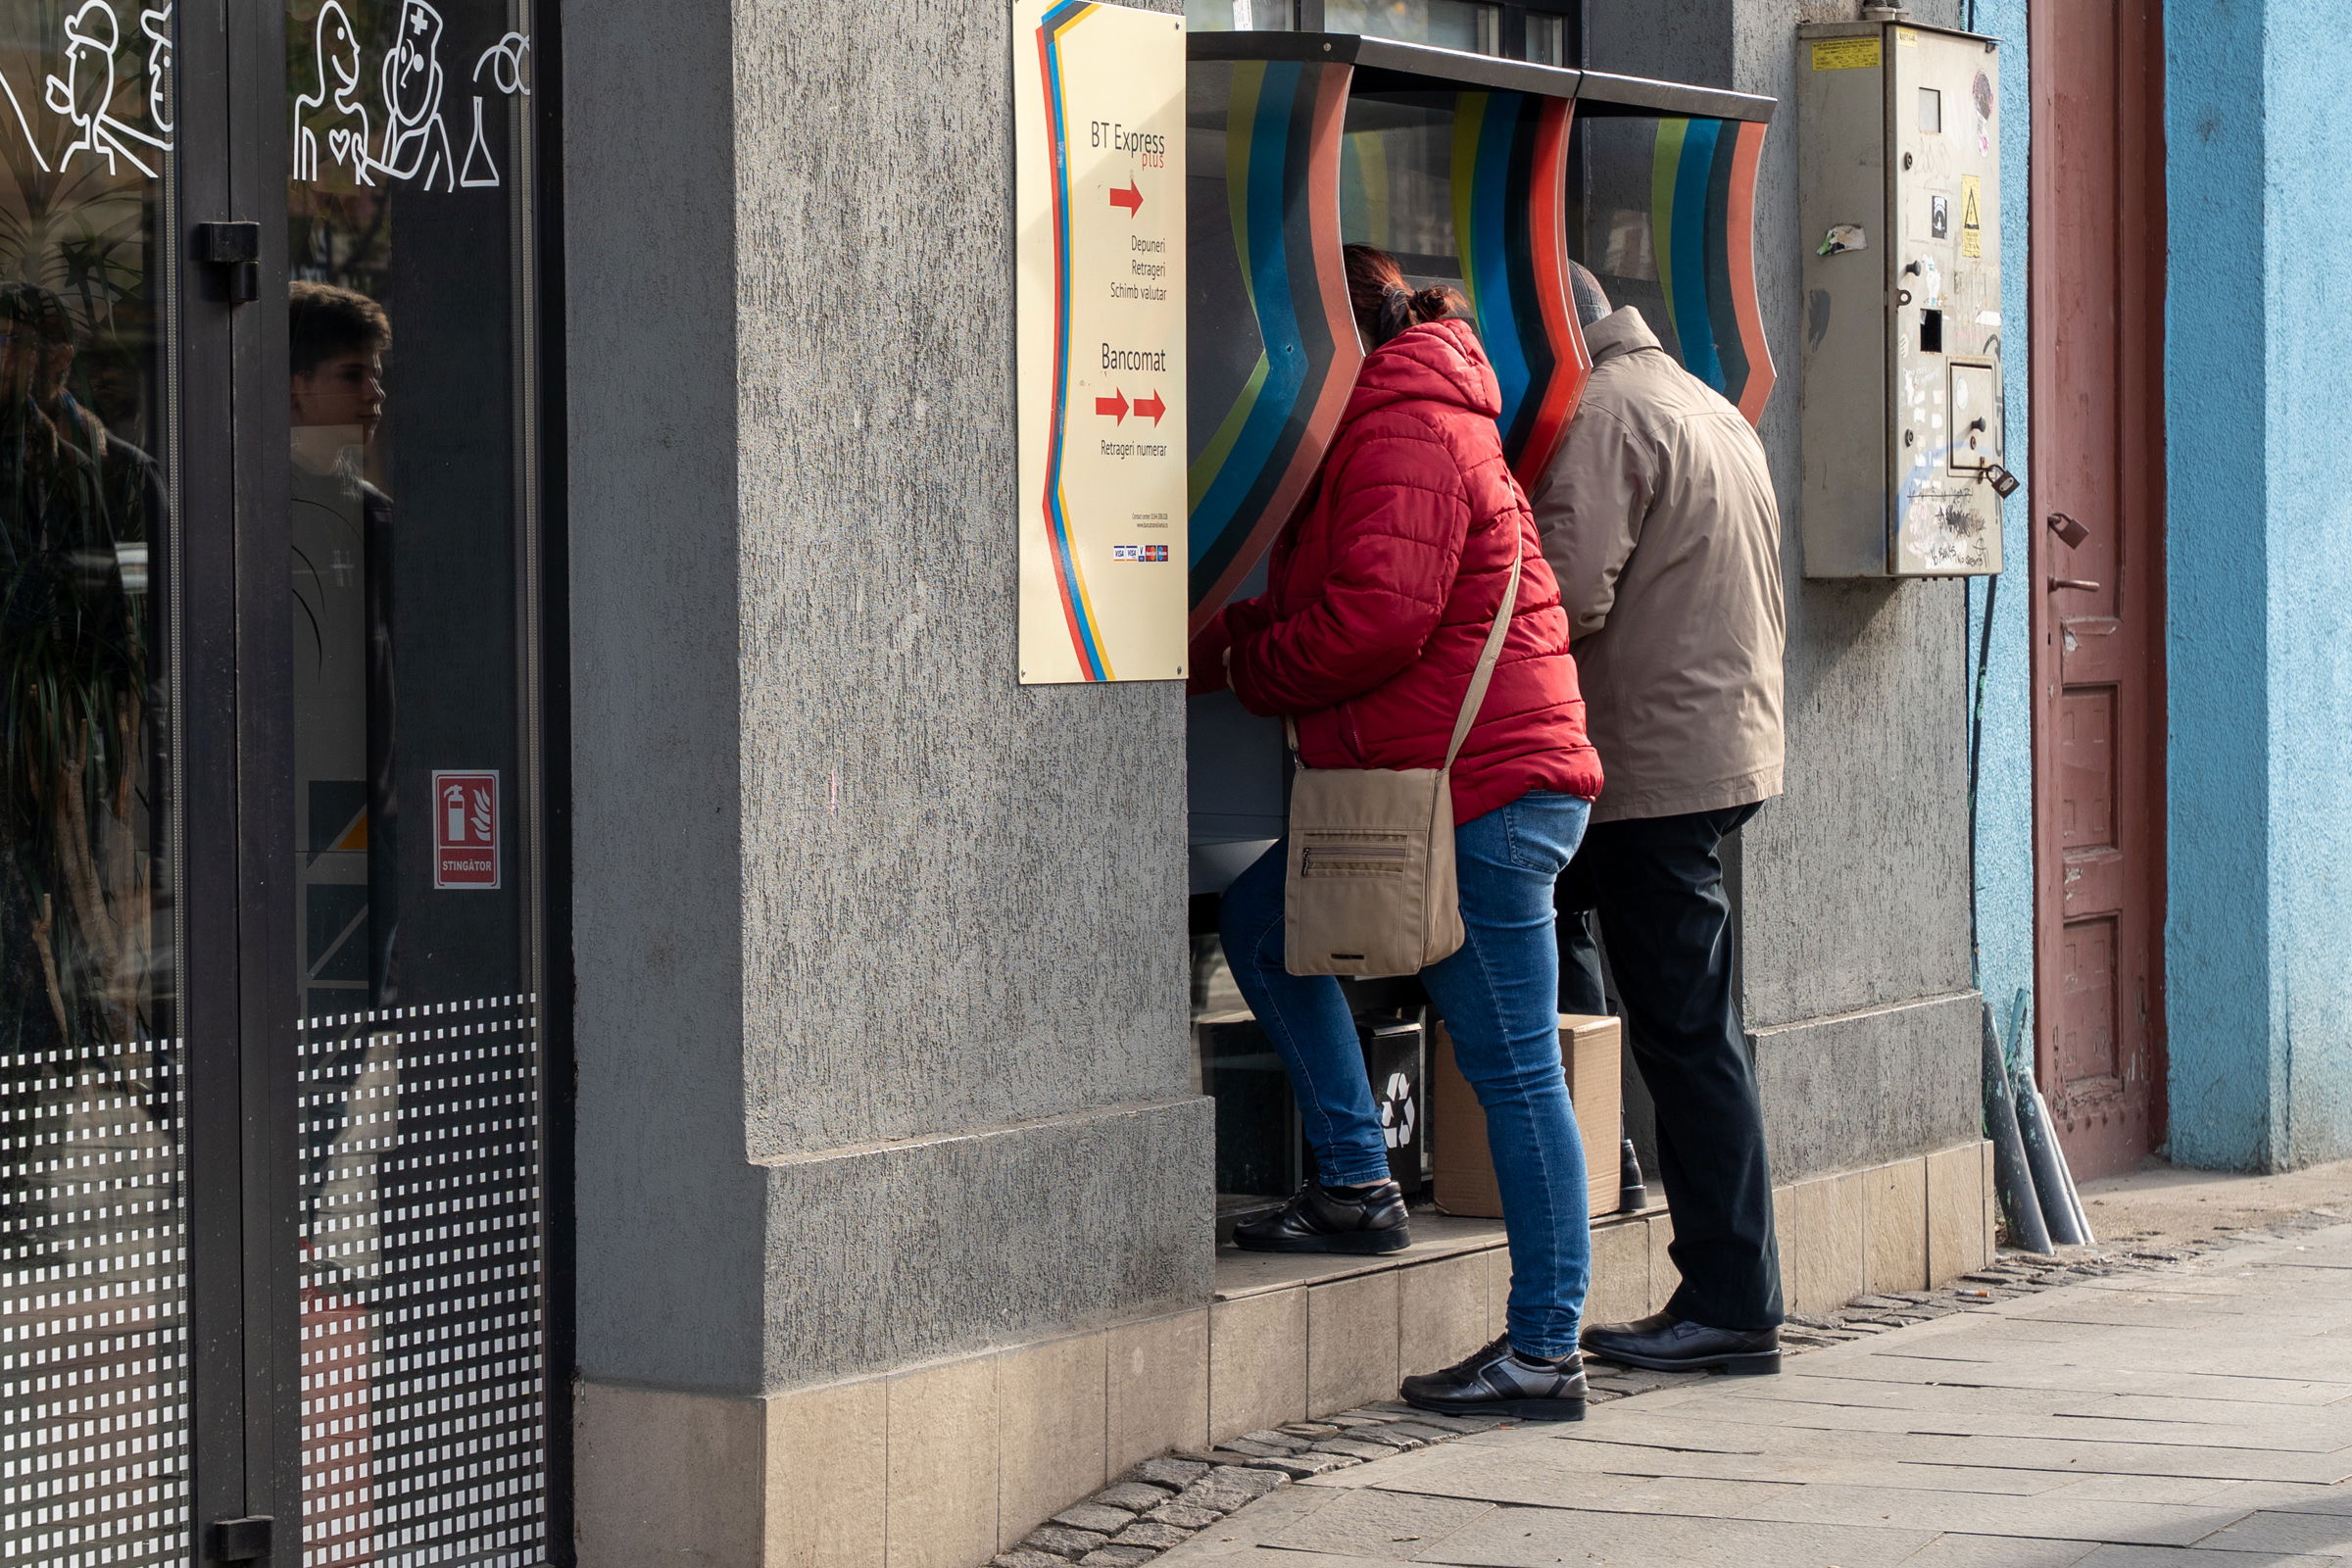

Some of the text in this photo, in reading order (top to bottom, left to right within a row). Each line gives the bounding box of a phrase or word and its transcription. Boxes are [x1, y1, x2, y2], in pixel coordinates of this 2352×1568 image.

[1091, 121, 1165, 159] BT Express
[1142, 152, 1164, 171] plus
[1131, 234, 1166, 255] Depuneri
[1131, 259, 1166, 280] Retrageri
[1110, 281, 1167, 301] Schimb valutar
[1102, 342, 1166, 371] Bancomat
[1101, 439, 1167, 460] Retrageri numerar
